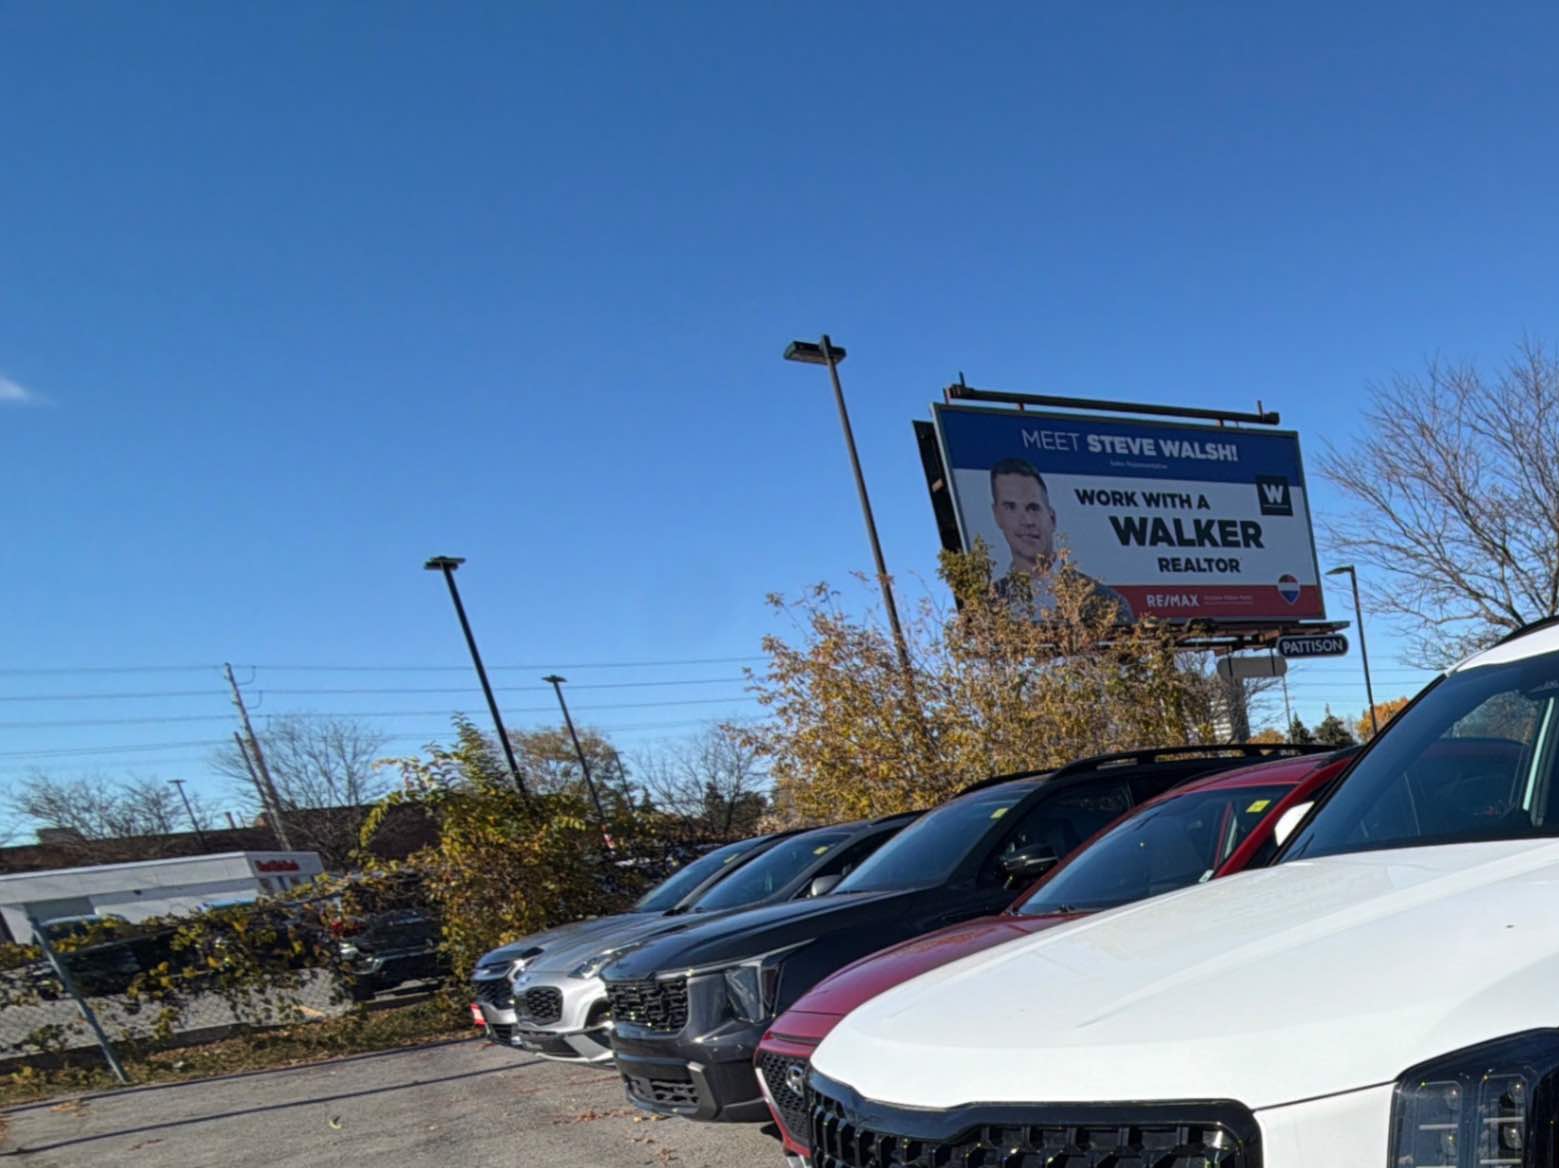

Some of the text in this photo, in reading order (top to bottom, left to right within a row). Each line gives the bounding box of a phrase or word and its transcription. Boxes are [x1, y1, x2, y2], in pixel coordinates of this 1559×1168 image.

[1022, 429, 1239, 462] MEET STEVE WALSH!
[1074, 488, 1211, 511] WORK WITH A
[1263, 484, 1283, 503] W
[1109, 516, 1264, 548] WALKER
[1158, 557, 1241, 574] REALTOR
[1146, 594, 1200, 608] RE/MAX
[1282, 639, 1344, 654] PATTISON
